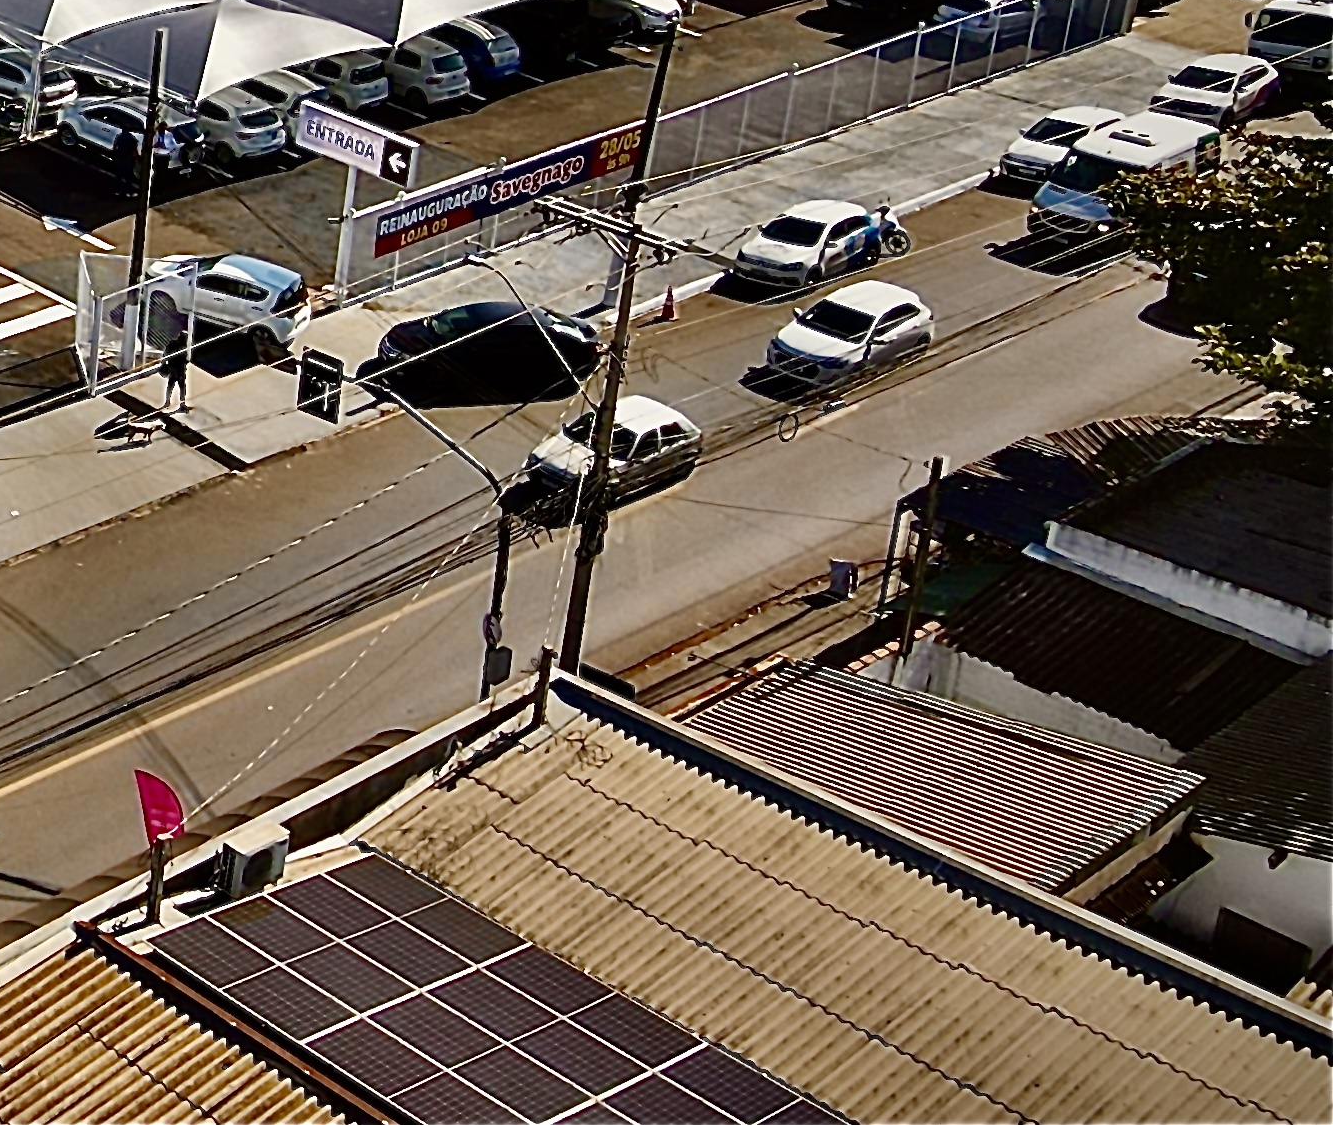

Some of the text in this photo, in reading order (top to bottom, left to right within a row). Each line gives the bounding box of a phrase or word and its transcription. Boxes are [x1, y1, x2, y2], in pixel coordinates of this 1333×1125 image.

[306, 119, 375, 161] ENTRADA
[599, 129, 642, 160] 28/05
[490, 156, 584, 204] Savegnago
[379, 184, 488, 236] REINAUGURAÇÃO
[400, 217, 448, 246] LOJA 09
